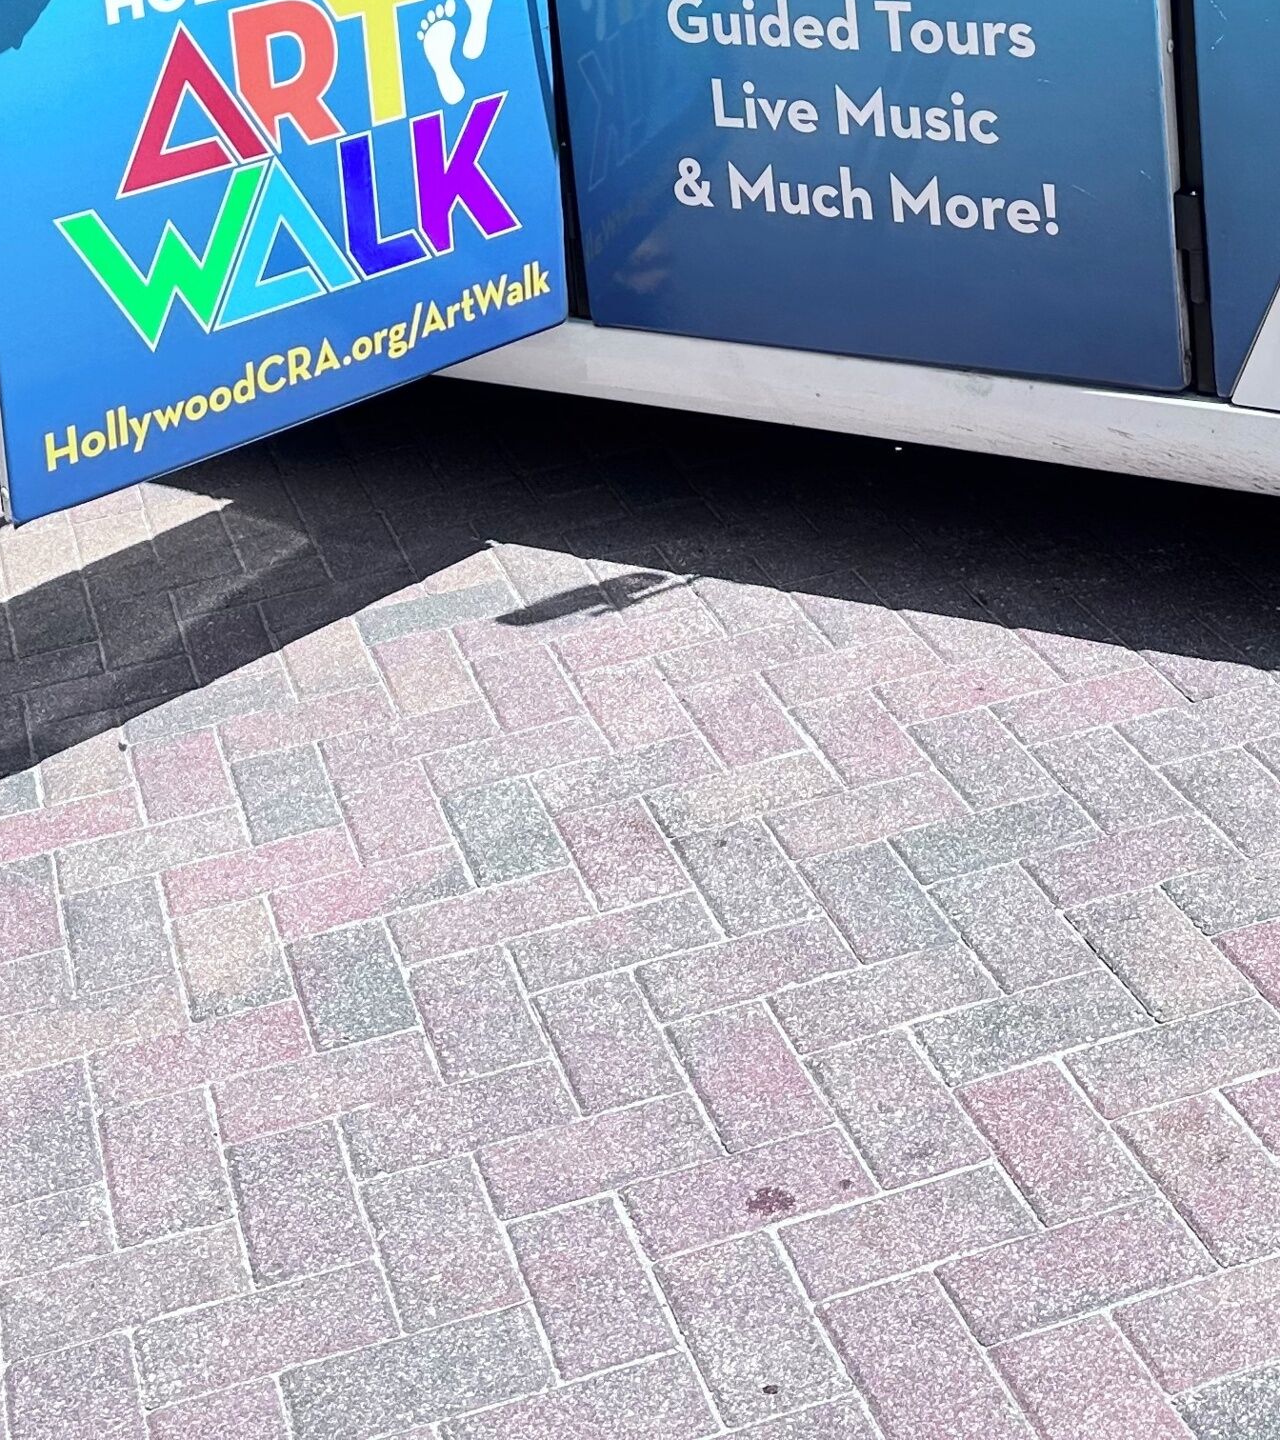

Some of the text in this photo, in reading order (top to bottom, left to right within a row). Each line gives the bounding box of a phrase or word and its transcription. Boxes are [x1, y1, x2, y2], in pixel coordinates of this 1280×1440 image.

[874, 1, 1037, 58] Tours
[710, 78, 1000, 145] Live Music
[54, 90, 523, 352] WALK
[673, 157, 1060, 236] & Much More!
[44, 262, 551, 472] HollywoodCRA.org/ArtWalk
